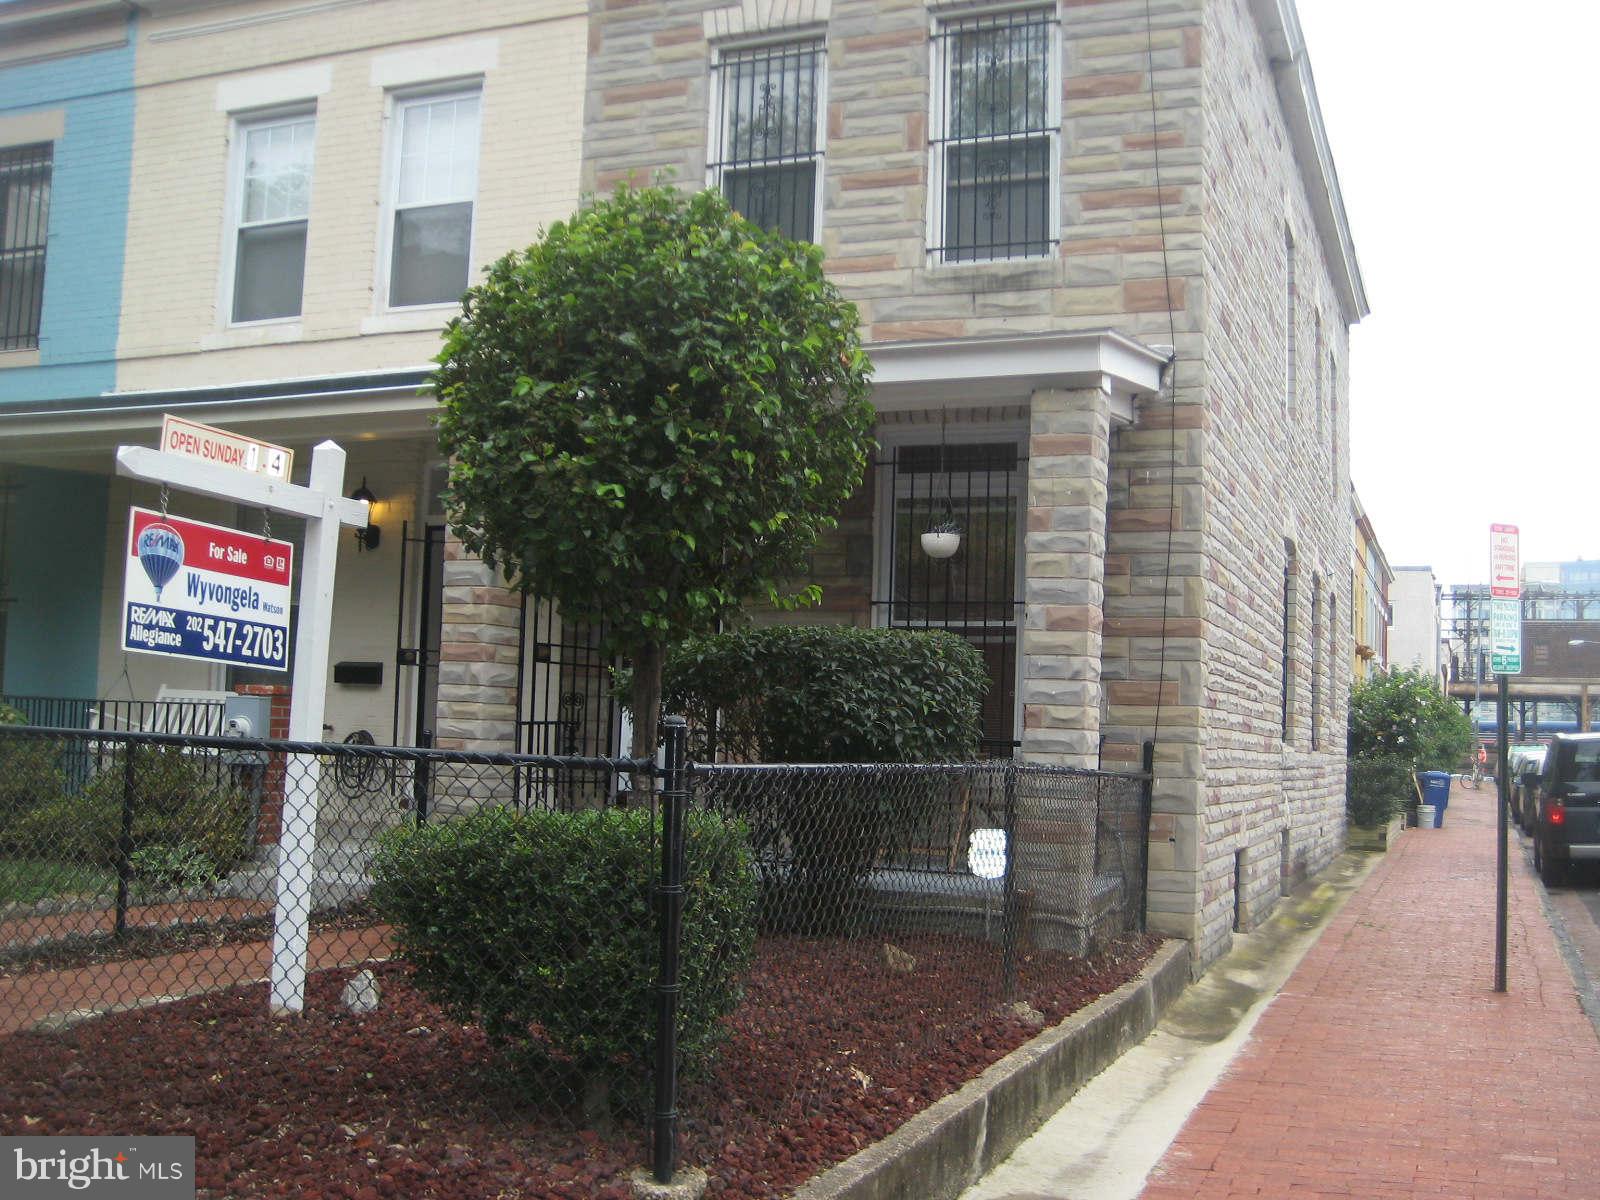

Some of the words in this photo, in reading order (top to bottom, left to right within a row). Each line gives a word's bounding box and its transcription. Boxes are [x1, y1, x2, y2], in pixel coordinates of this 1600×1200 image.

[170, 430, 200, 455] OPEN
[202, 440, 245, 467] SUNDAY
[209, 542, 225, 560] For
[227, 546, 248, 565] Sale
[187, 572, 259, 612] Wyvongela
[262, 602, 284, 615] Watson
[131, 606, 176, 629] RE/MAX
[130, 624, 182, 647] Allegiance
[186, 615, 202, 633] 202
[202, 618, 284, 661] 547-2703
